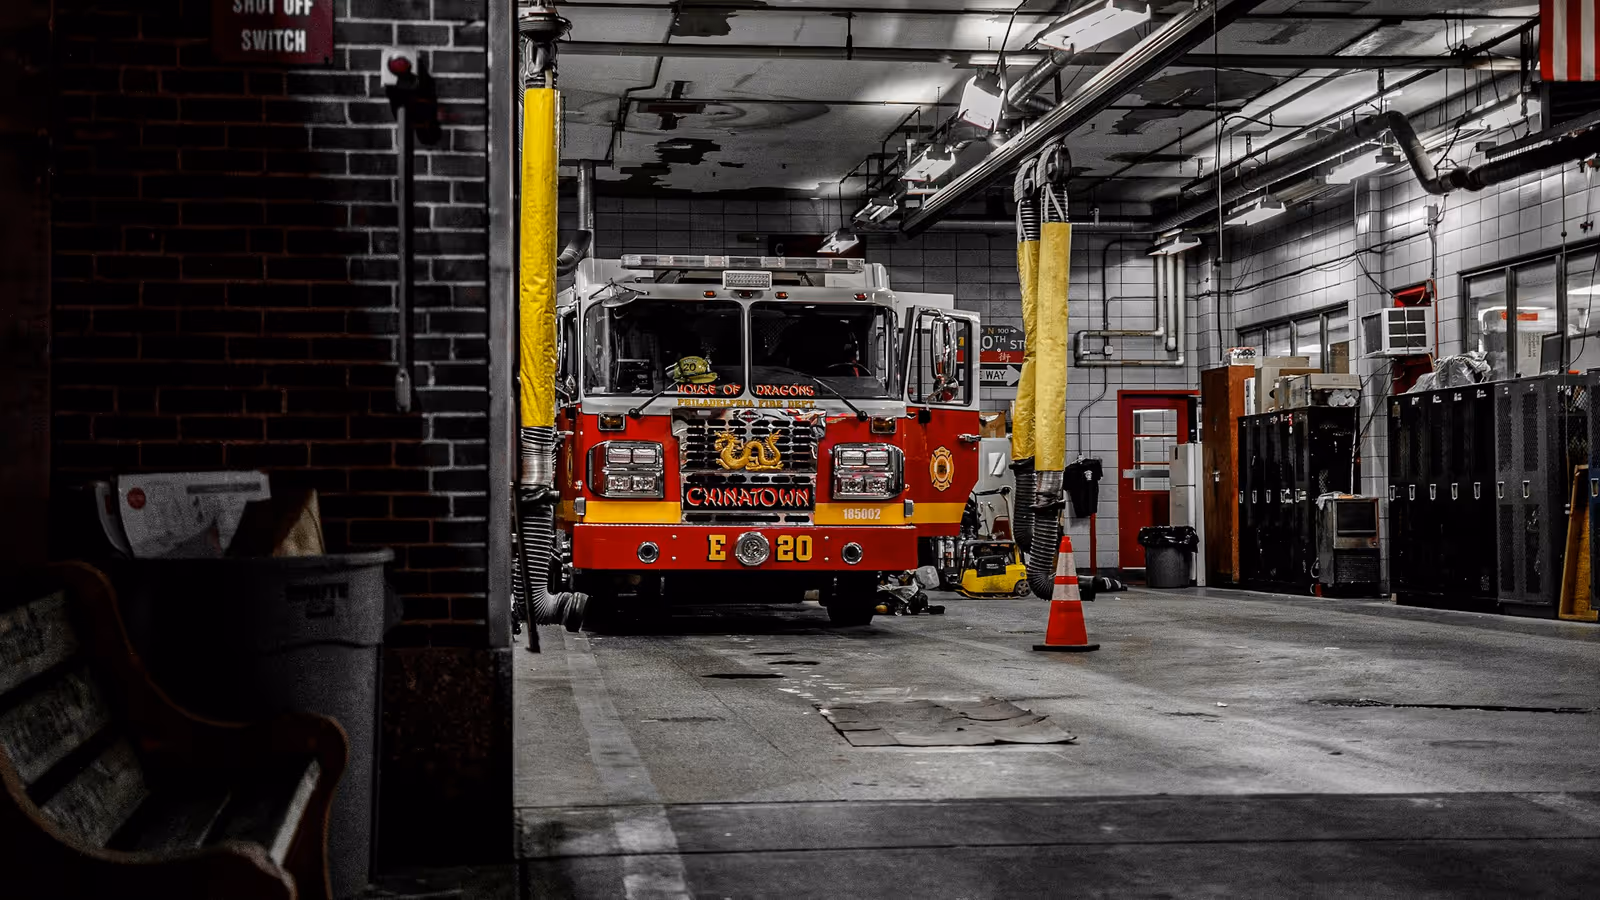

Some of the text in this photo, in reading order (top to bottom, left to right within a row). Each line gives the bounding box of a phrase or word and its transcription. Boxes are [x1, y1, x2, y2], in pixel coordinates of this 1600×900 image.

[232, 0, 314, 16] SHUT OFF
[241, 29, 306, 52] SWITCH
[982, 335, 1006, 349] 0TH
[683, 363, 696, 371] 20
[985, 370, 1006, 380] WAY
[676, 384, 815, 396] HOUSE OF DRAGONS
[677, 398, 817, 408] PHILADELPHIA FIRE DEPT.
[686, 486, 810, 507] CHINATOWN
[842, 508, 881, 520] 185002
[708, 534, 813, 561] E 20
